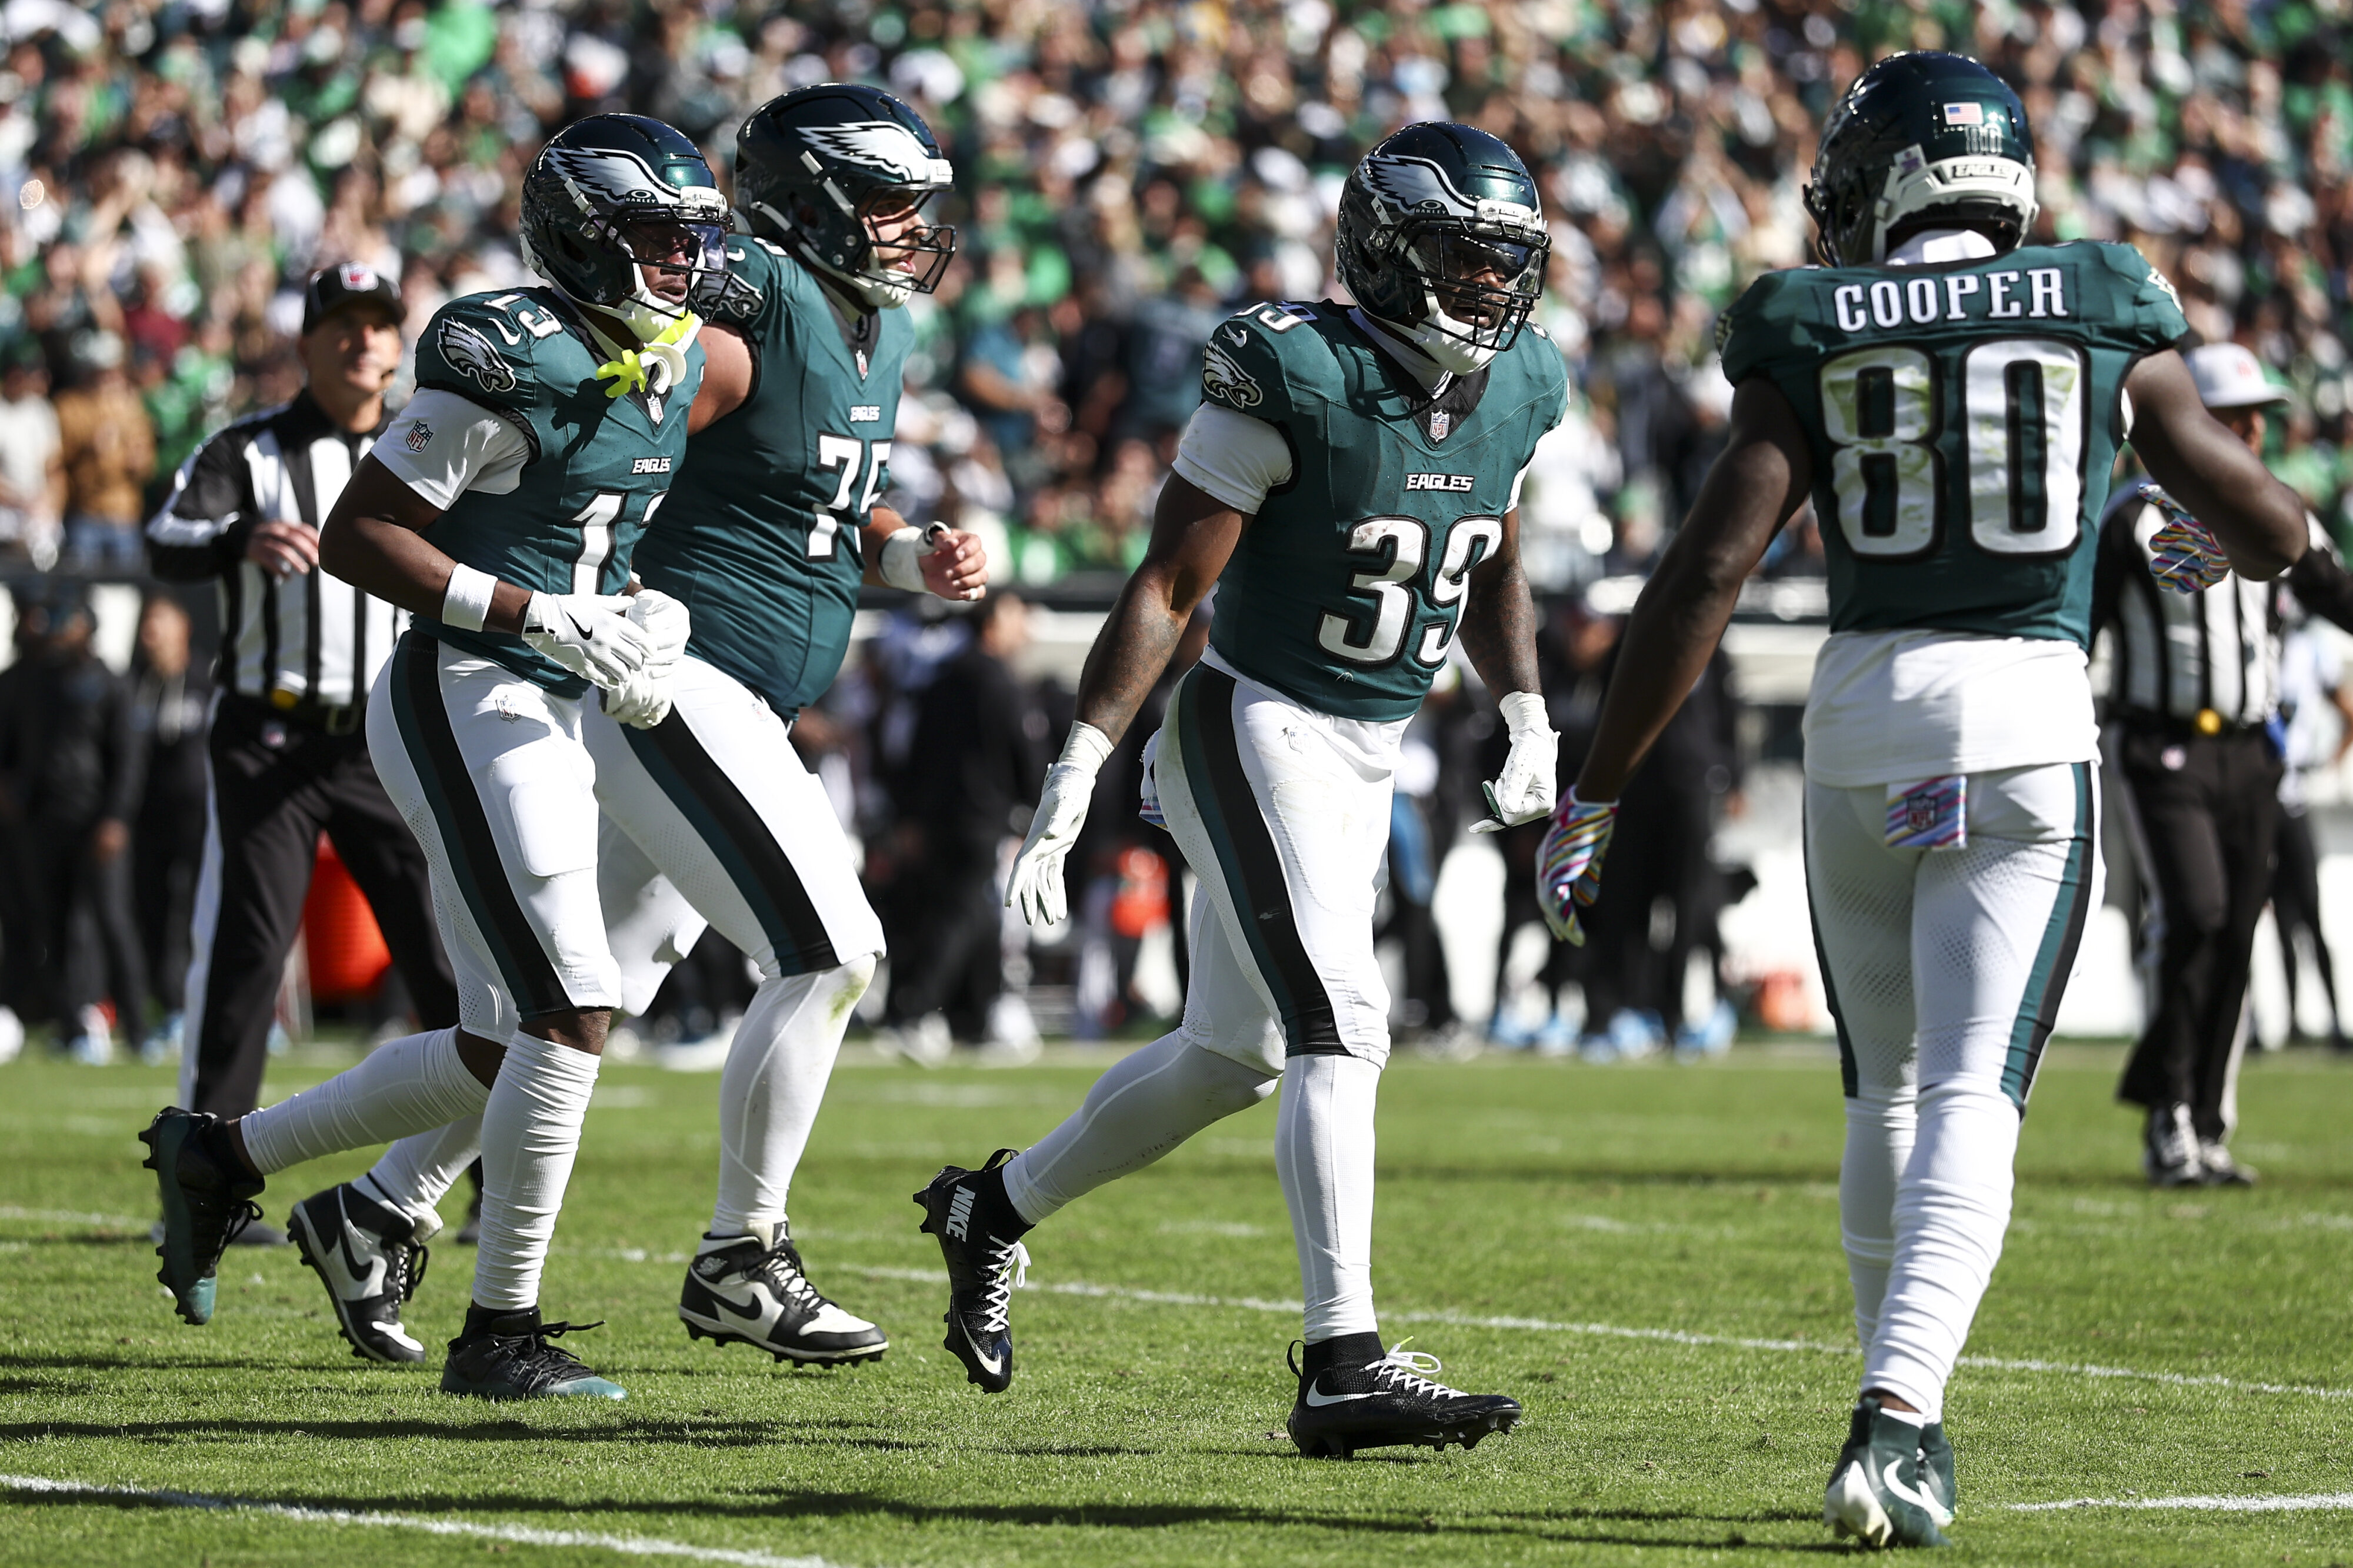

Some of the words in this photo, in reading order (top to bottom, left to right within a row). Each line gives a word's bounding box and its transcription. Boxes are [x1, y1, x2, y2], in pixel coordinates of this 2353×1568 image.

[1964, 124, 2002, 156] 80
[1955, 165, 2010, 178] EAGLES
[1834, 268, 2069, 332] COOPER
[408, 431, 424, 451] NFL
[1433, 424, 1445, 436] NFL
[1819, 338, 2085, 556] 80
[632, 458, 671, 474] EAGLES
[1407, 473, 1475, 492] EAGLES
[571, 492, 668, 595] 1
[1317, 515, 1503, 665] 39
[945, 1184, 976, 1243] NIKE
